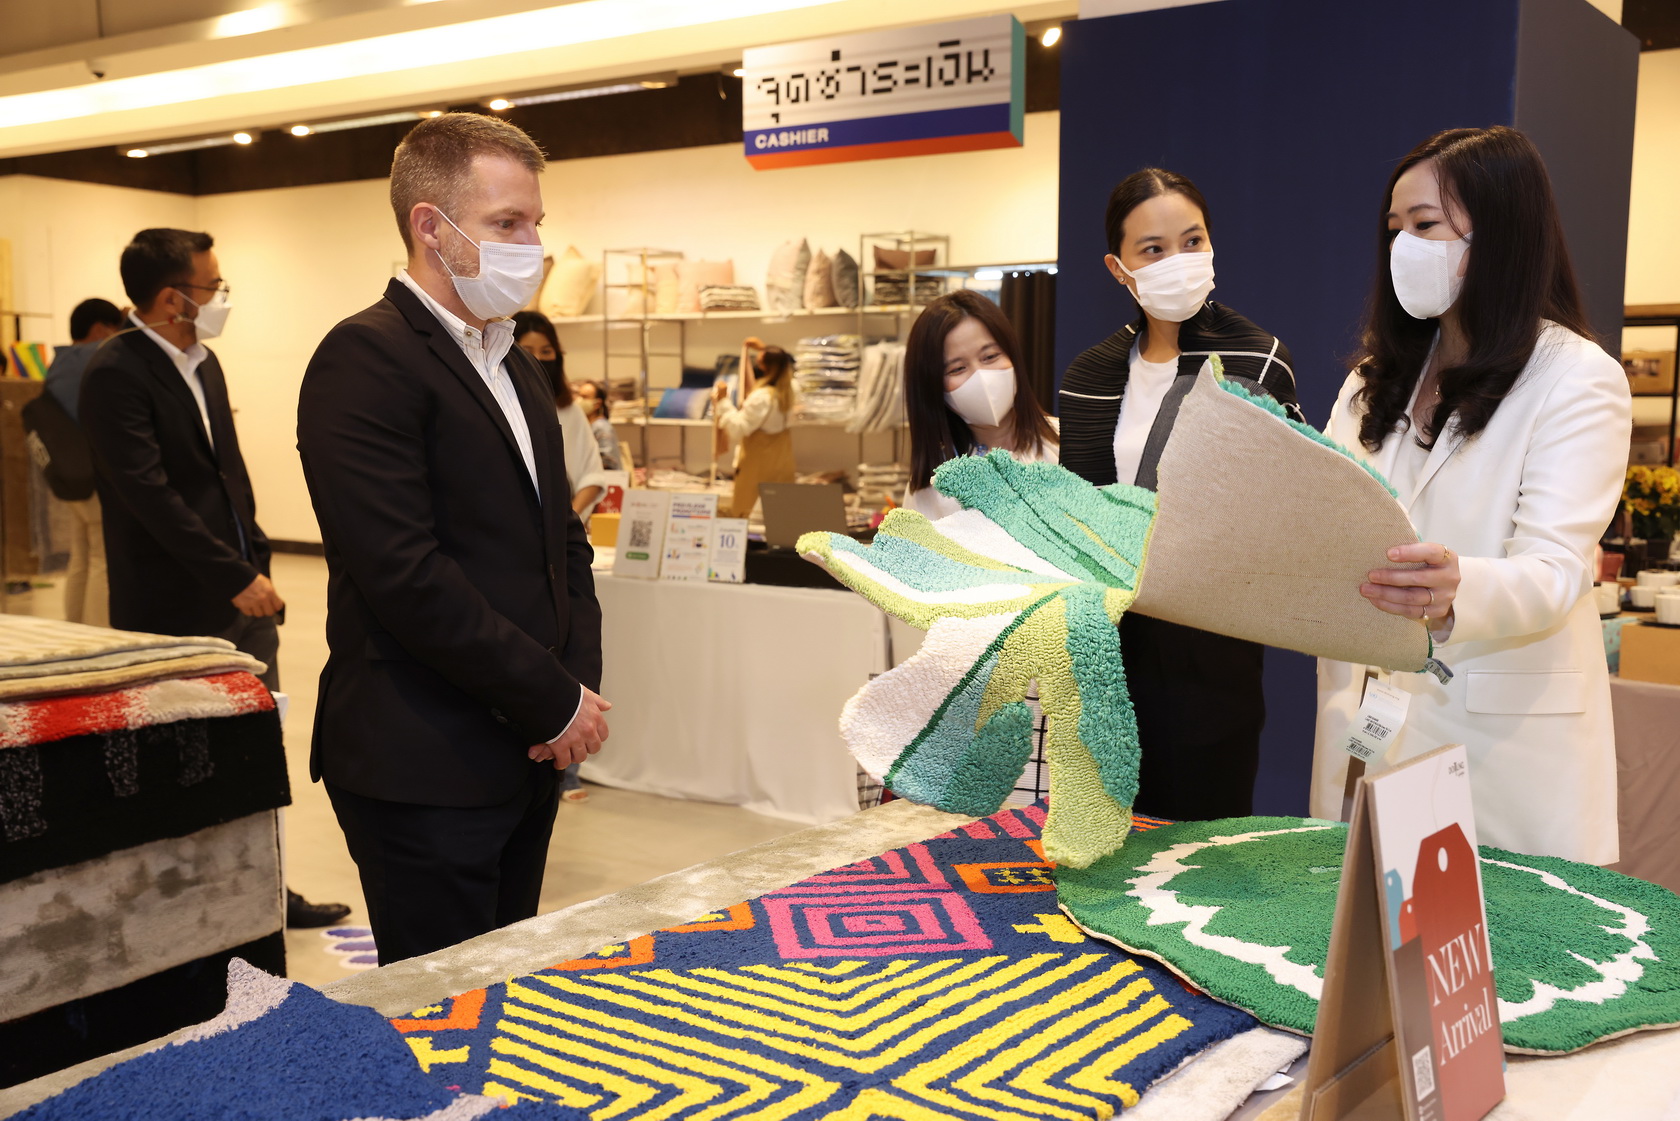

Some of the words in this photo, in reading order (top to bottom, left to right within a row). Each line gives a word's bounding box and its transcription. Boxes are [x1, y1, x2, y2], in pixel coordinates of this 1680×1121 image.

[757, 39, 996, 124] จุดชำระเงิน
[754, 127, 830, 149] CASHIER
[719, 533, 736, 549] 10
[1427, 922, 1481, 1007] NEW
[1440, 986, 1493, 1066] Arrival
